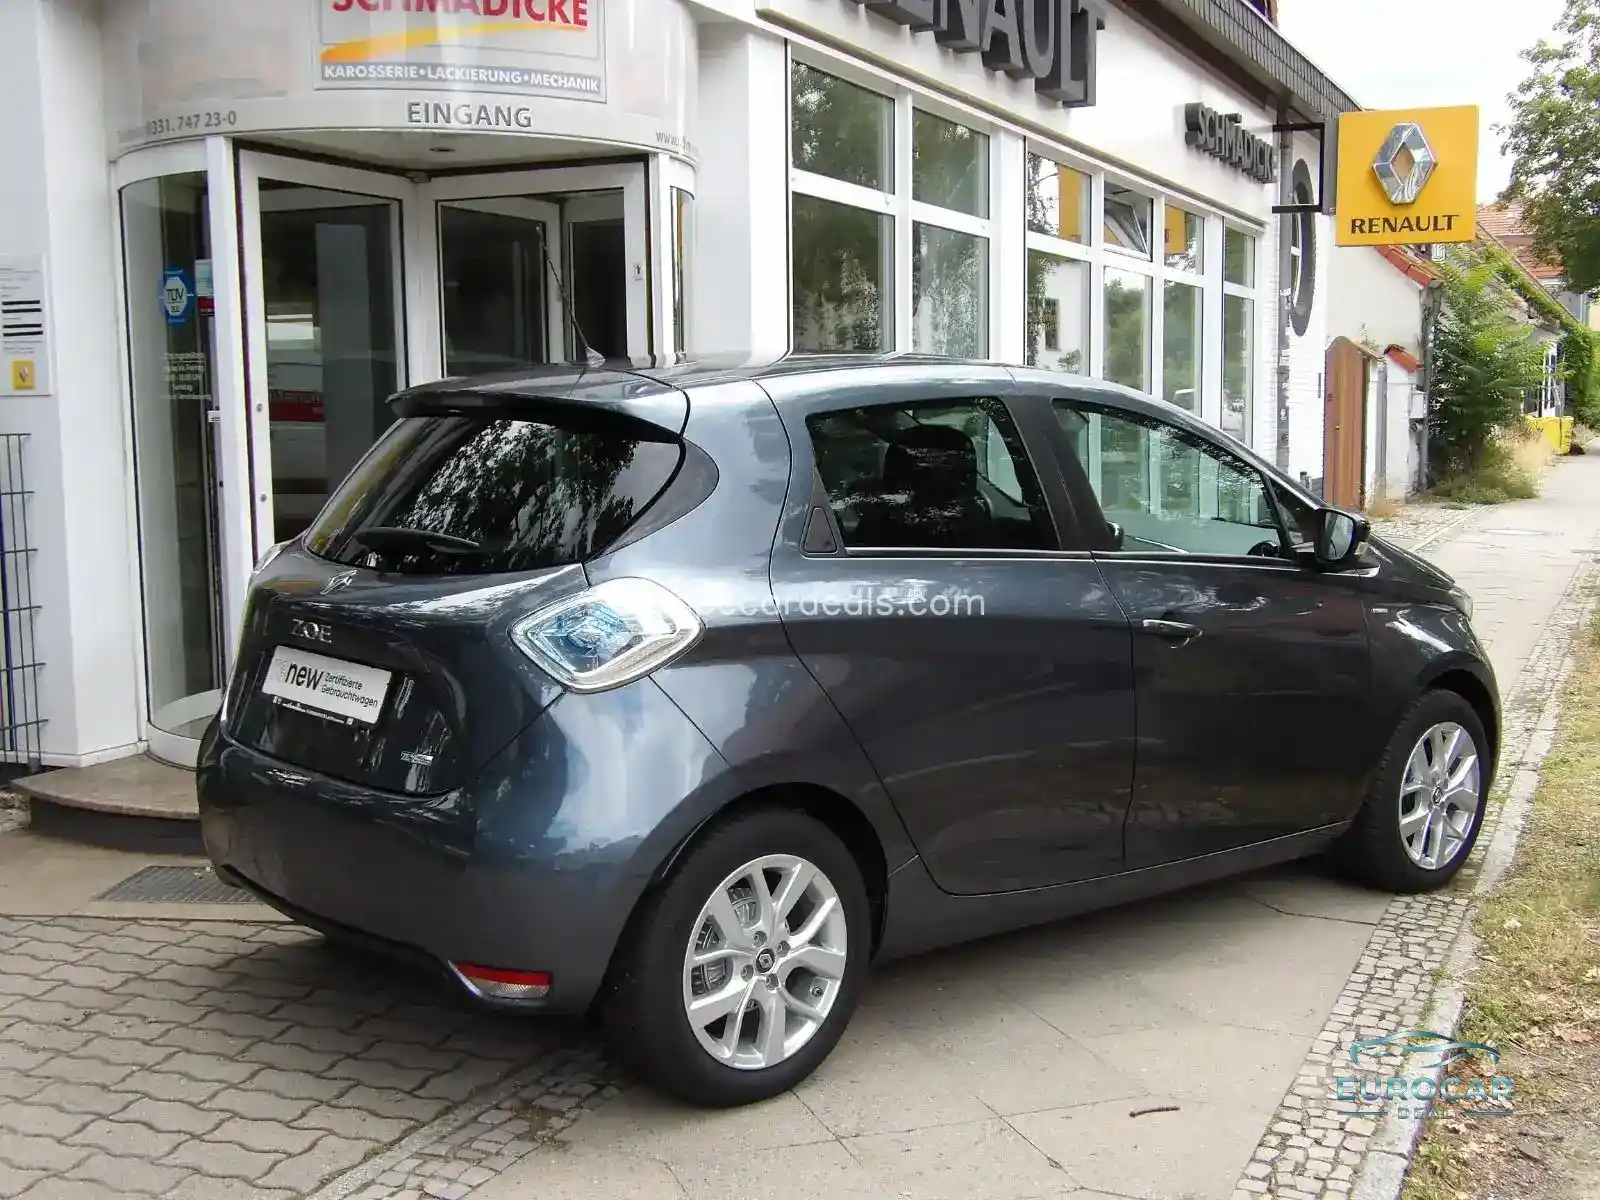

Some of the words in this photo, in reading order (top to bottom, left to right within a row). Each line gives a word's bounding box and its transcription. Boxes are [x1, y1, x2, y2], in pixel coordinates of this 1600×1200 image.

[836, 0, 1104, 107] AULT
[324, 64, 419, 80] KAROSSERIE
[426, 68, 523, 85] LACKIERUNG
[529, 75, 600, 92] MECHANIK
[204, 110, 238, 128] 23-0
[407, 101, 532, 128] EINGANG
[1350, 214, 1460, 235] RENAULT
[289, 618, 333, 644] ZOE
[320, 683, 379, 709] Gebrauchtwagen
